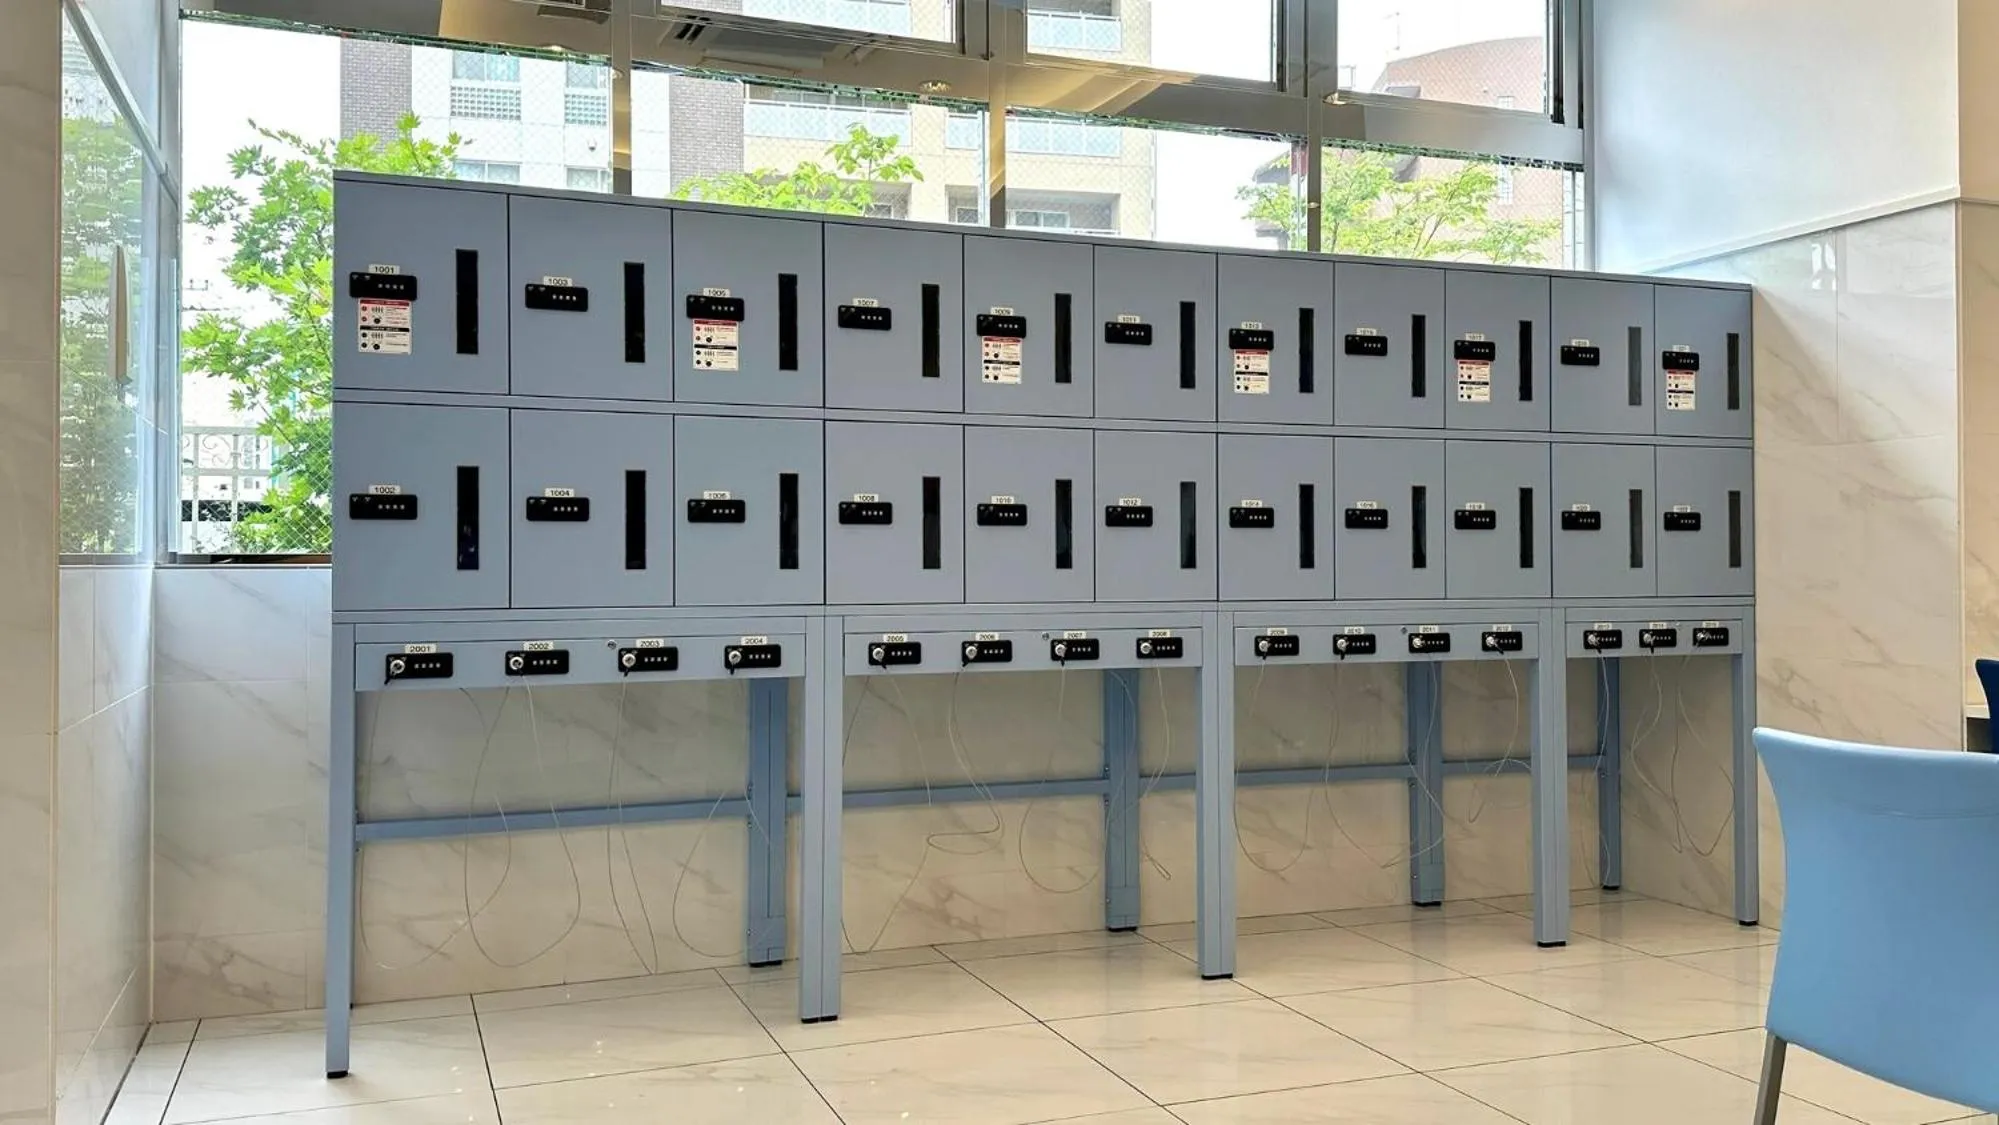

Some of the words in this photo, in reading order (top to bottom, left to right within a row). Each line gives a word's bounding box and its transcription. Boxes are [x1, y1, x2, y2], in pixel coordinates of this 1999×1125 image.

[375, 265, 395, 274] 1001
[548, 277, 569, 286] 1003
[374, 486, 396, 494] 1002
[550, 489, 571, 497] 1004
[745, 637, 763, 645] 2004
[886, 635, 904, 643] 2005
[528, 642, 550, 650] 2002
[640, 640, 660, 648] 2003
[409, 645, 431, 653] 2001
